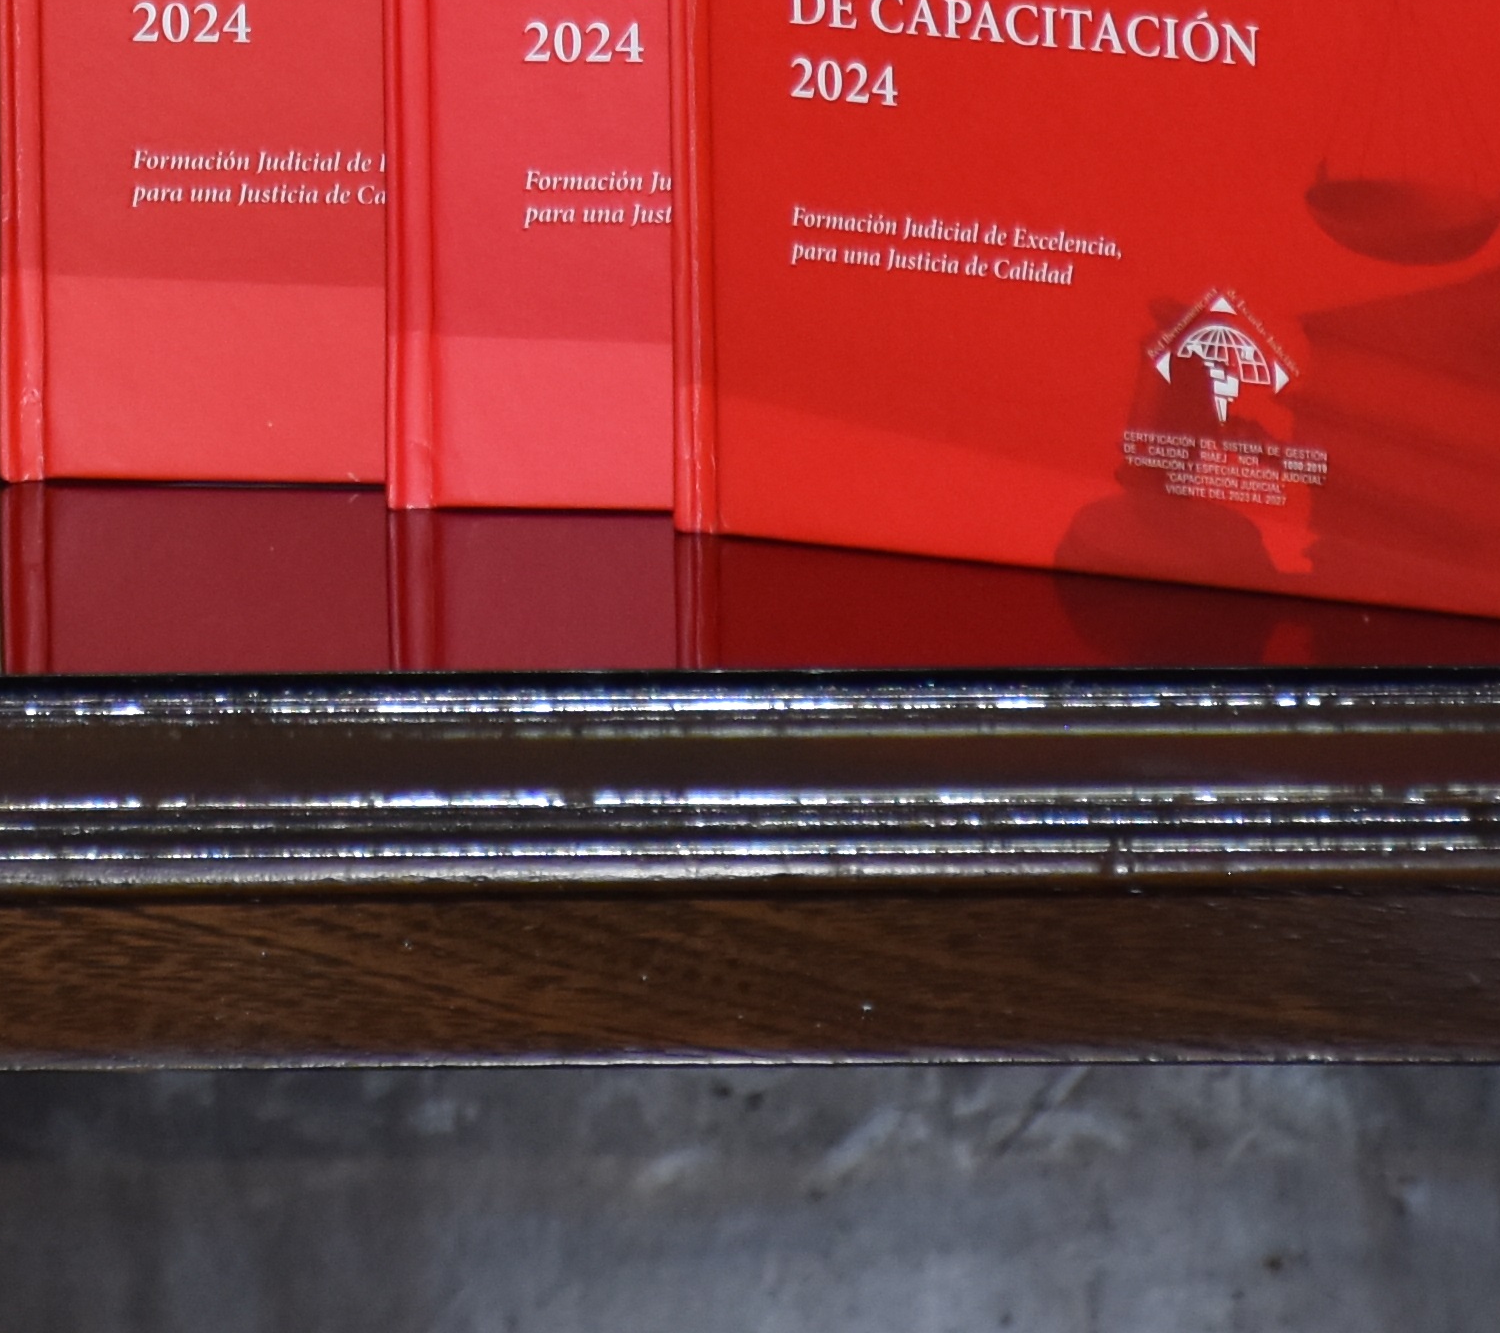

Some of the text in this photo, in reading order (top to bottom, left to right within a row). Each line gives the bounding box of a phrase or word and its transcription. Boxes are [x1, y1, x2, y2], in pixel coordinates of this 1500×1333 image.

[132, 2, 251, 44] 2024
[523, 22, 644, 63] 2024
[790, 58, 898, 107] 2024
[133, 150, 250, 172] Formación
[256, 150, 341, 175] Judicial
[346, 150, 372, 173] de
[524, 170, 643, 193] Formación
[132, 185, 182, 208] para
[190, 185, 231, 204] una
[239, 183, 318, 206] Justicia
[325, 184, 350, 205] de
[523, 205, 575, 229] para
[582, 206, 625, 224] una
[792, 207, 1122, 260] Formación Judicial de Excelencia,
[791, 242, 1074, 286] para una Justicia de Calidad
